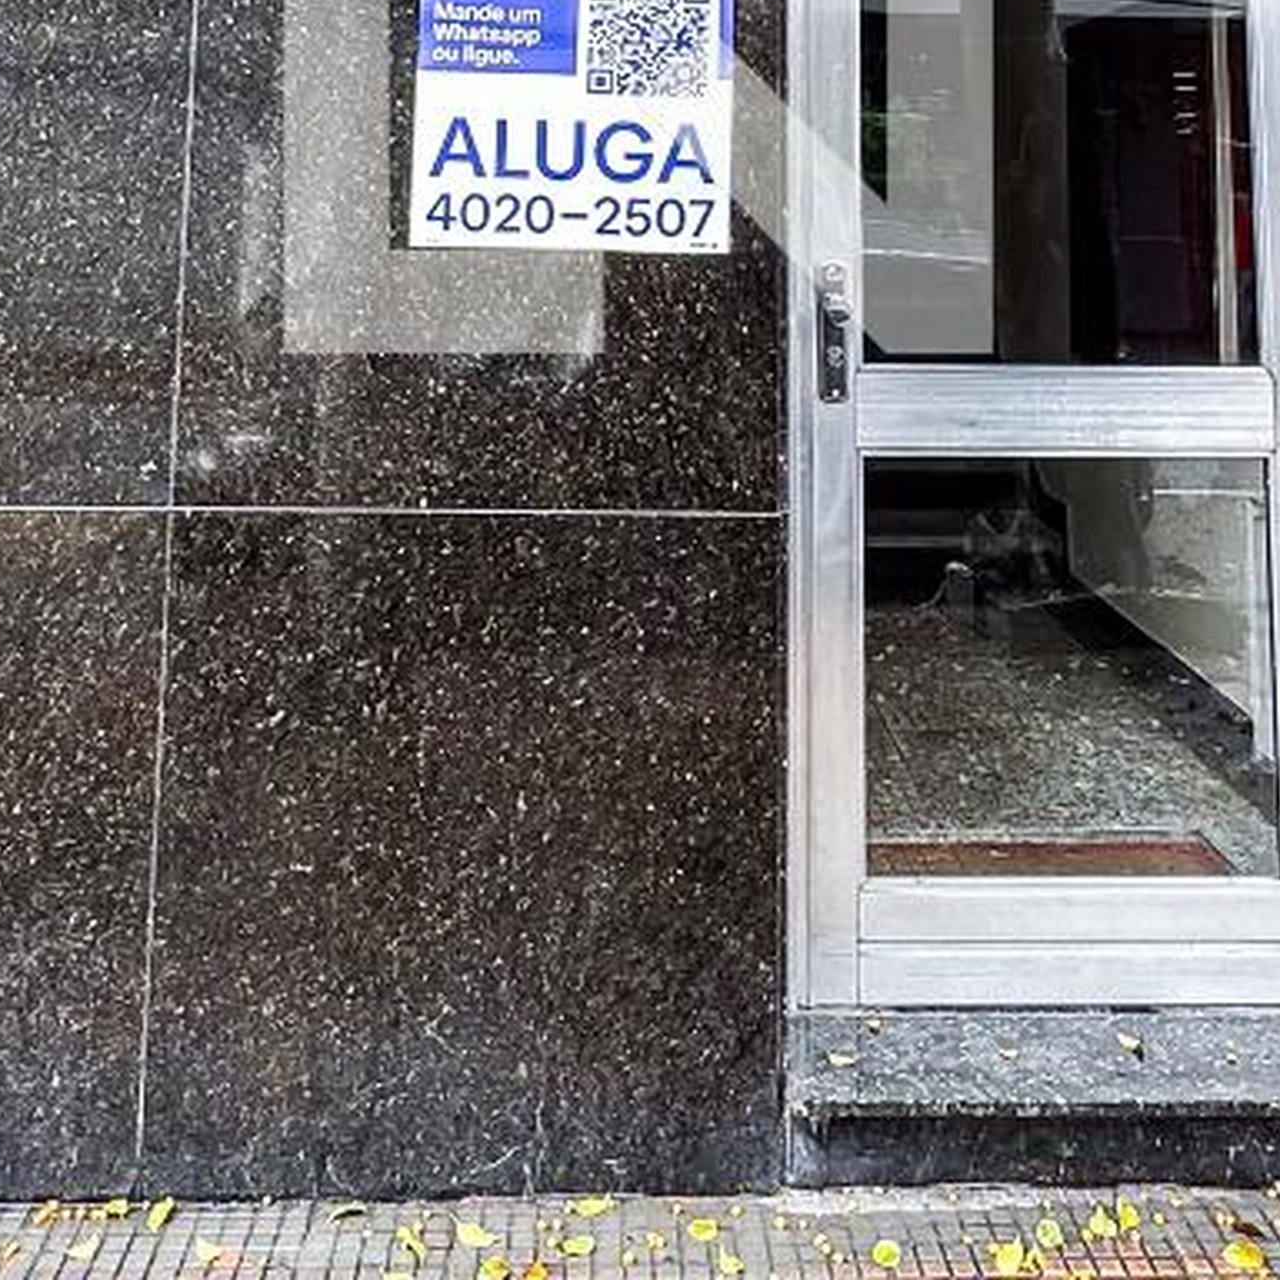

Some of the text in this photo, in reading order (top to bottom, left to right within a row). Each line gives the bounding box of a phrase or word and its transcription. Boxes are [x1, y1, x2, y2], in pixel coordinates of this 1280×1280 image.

[433, 1, 542, 24] Mande um
[432, 22, 541, 48] Whatsapp
[432, 43, 521, 68] ou ligue.
[429, 116, 714, 184] ALUGA
[426, 192, 716, 239] 4020-2507
